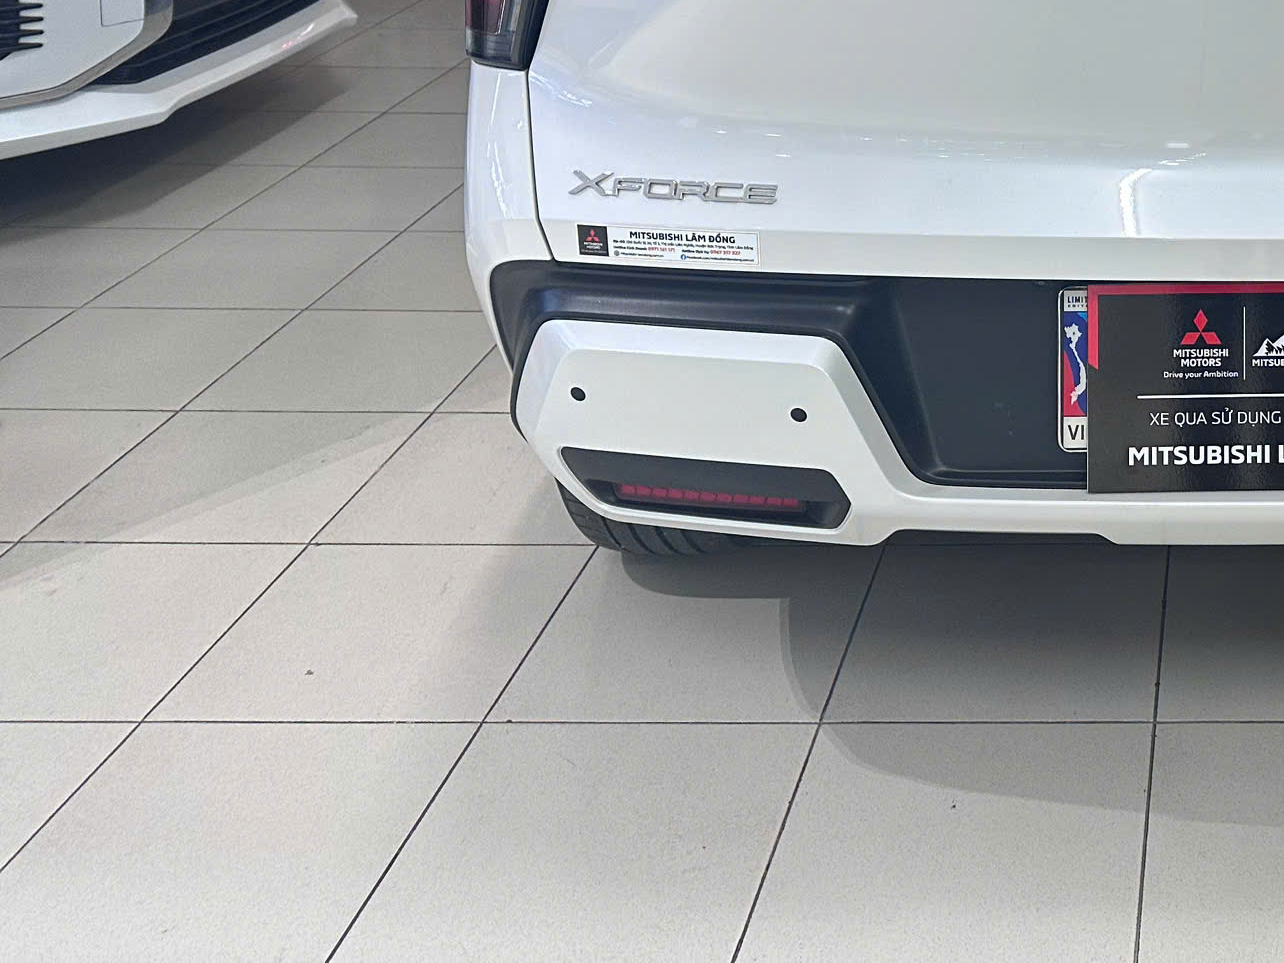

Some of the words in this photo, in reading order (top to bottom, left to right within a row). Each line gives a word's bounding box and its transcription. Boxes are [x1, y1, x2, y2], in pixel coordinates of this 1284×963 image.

[568, 169, 778, 205] XFORCE
[629, 230, 684, 243] MITSUBISHI
[1173, 348, 1229, 358] MITSUBISHI
[1180, 358, 1222, 368] MOTORS
[1163, 370, 1184, 379] Drive
[1184, 371, 1202, 380] your
[1203, 369, 1239, 379] Ambition
[1150, 412, 1169, 426] XE
[1174, 411, 1208, 428] QUA
[1211, 407, 1234, 425] SỬ
[1237, 410, 1281, 427] DỤNG
[1128, 444, 1271, 467] MITSUBISHI
